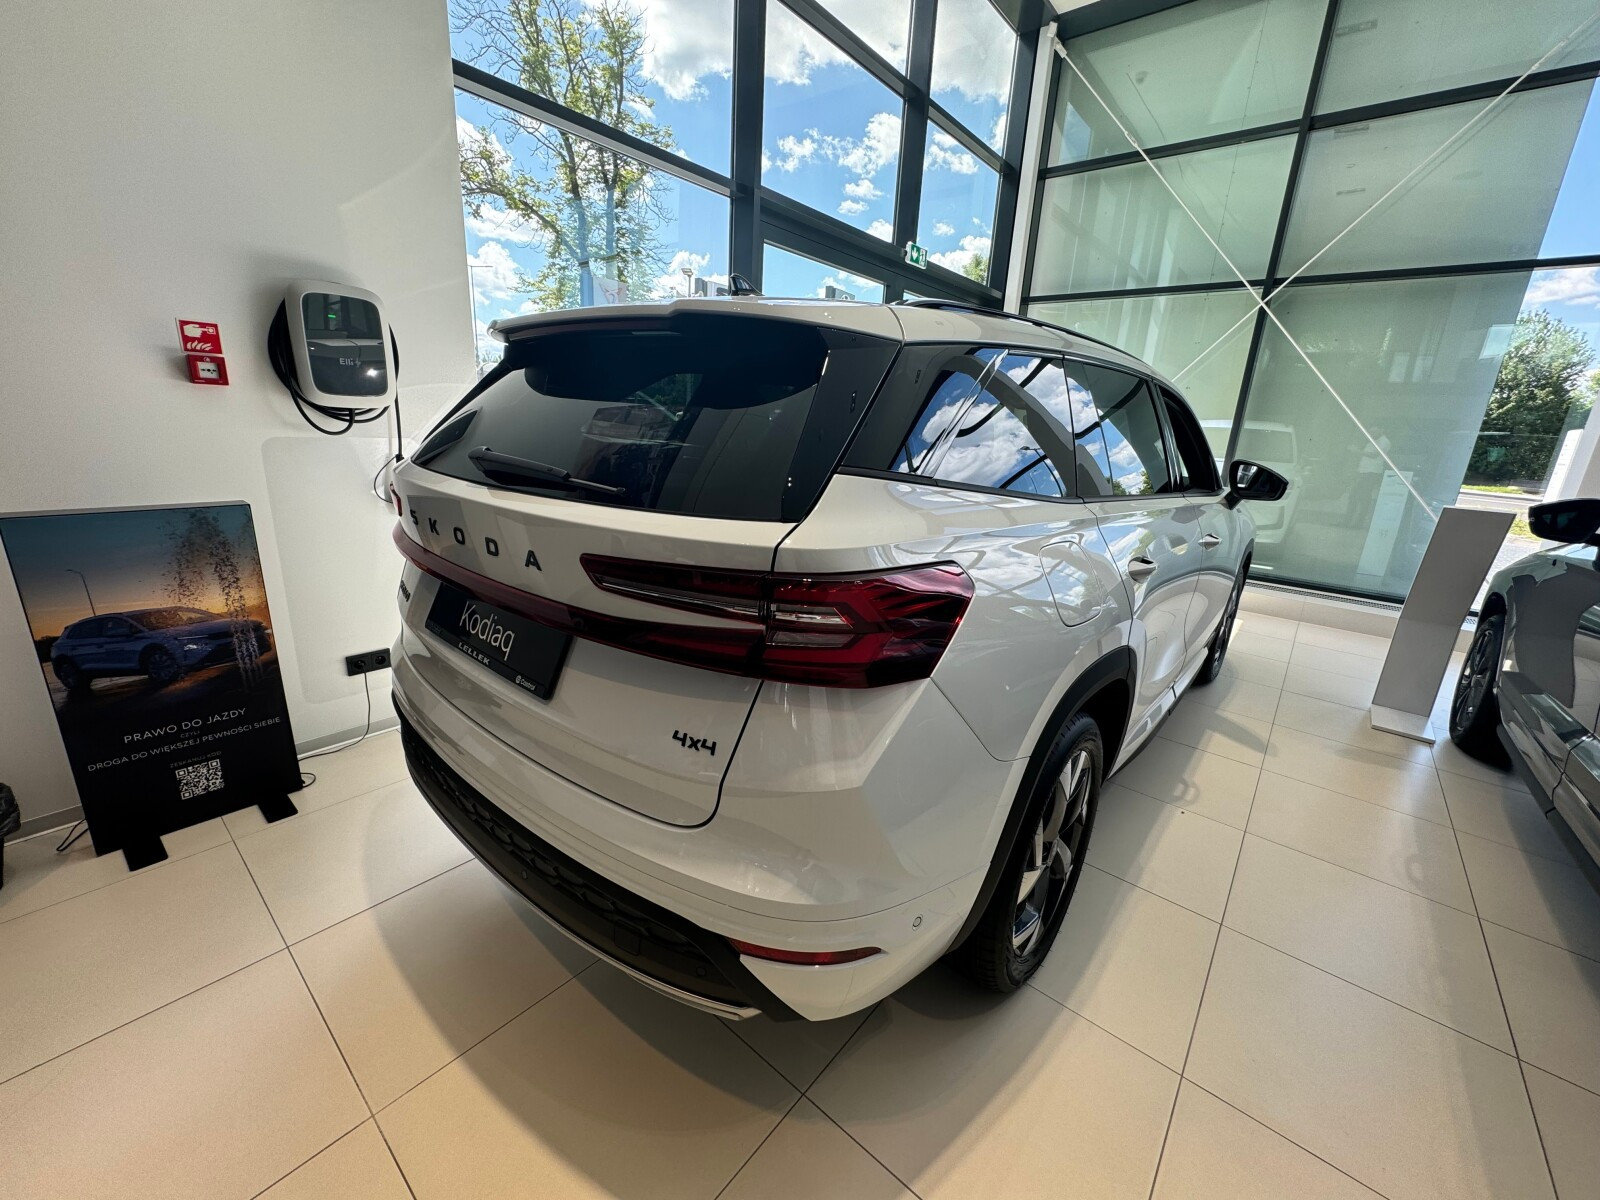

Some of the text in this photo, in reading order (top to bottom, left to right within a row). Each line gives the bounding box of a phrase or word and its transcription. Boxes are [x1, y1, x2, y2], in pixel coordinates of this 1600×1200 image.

[459, 600, 516, 662] Kodiaq
[458, 641, 490, 666] LELLEK
[87, 756, 130, 772] DROGA
[131, 751, 148, 761] DO
[149, 738, 200, 756] WIĘKSZEJ
[253, 716, 281, 730] SIEBIE
[123, 707, 247, 744] PRAWO DO JAZDY
[671, 729, 717, 757] 4x4
